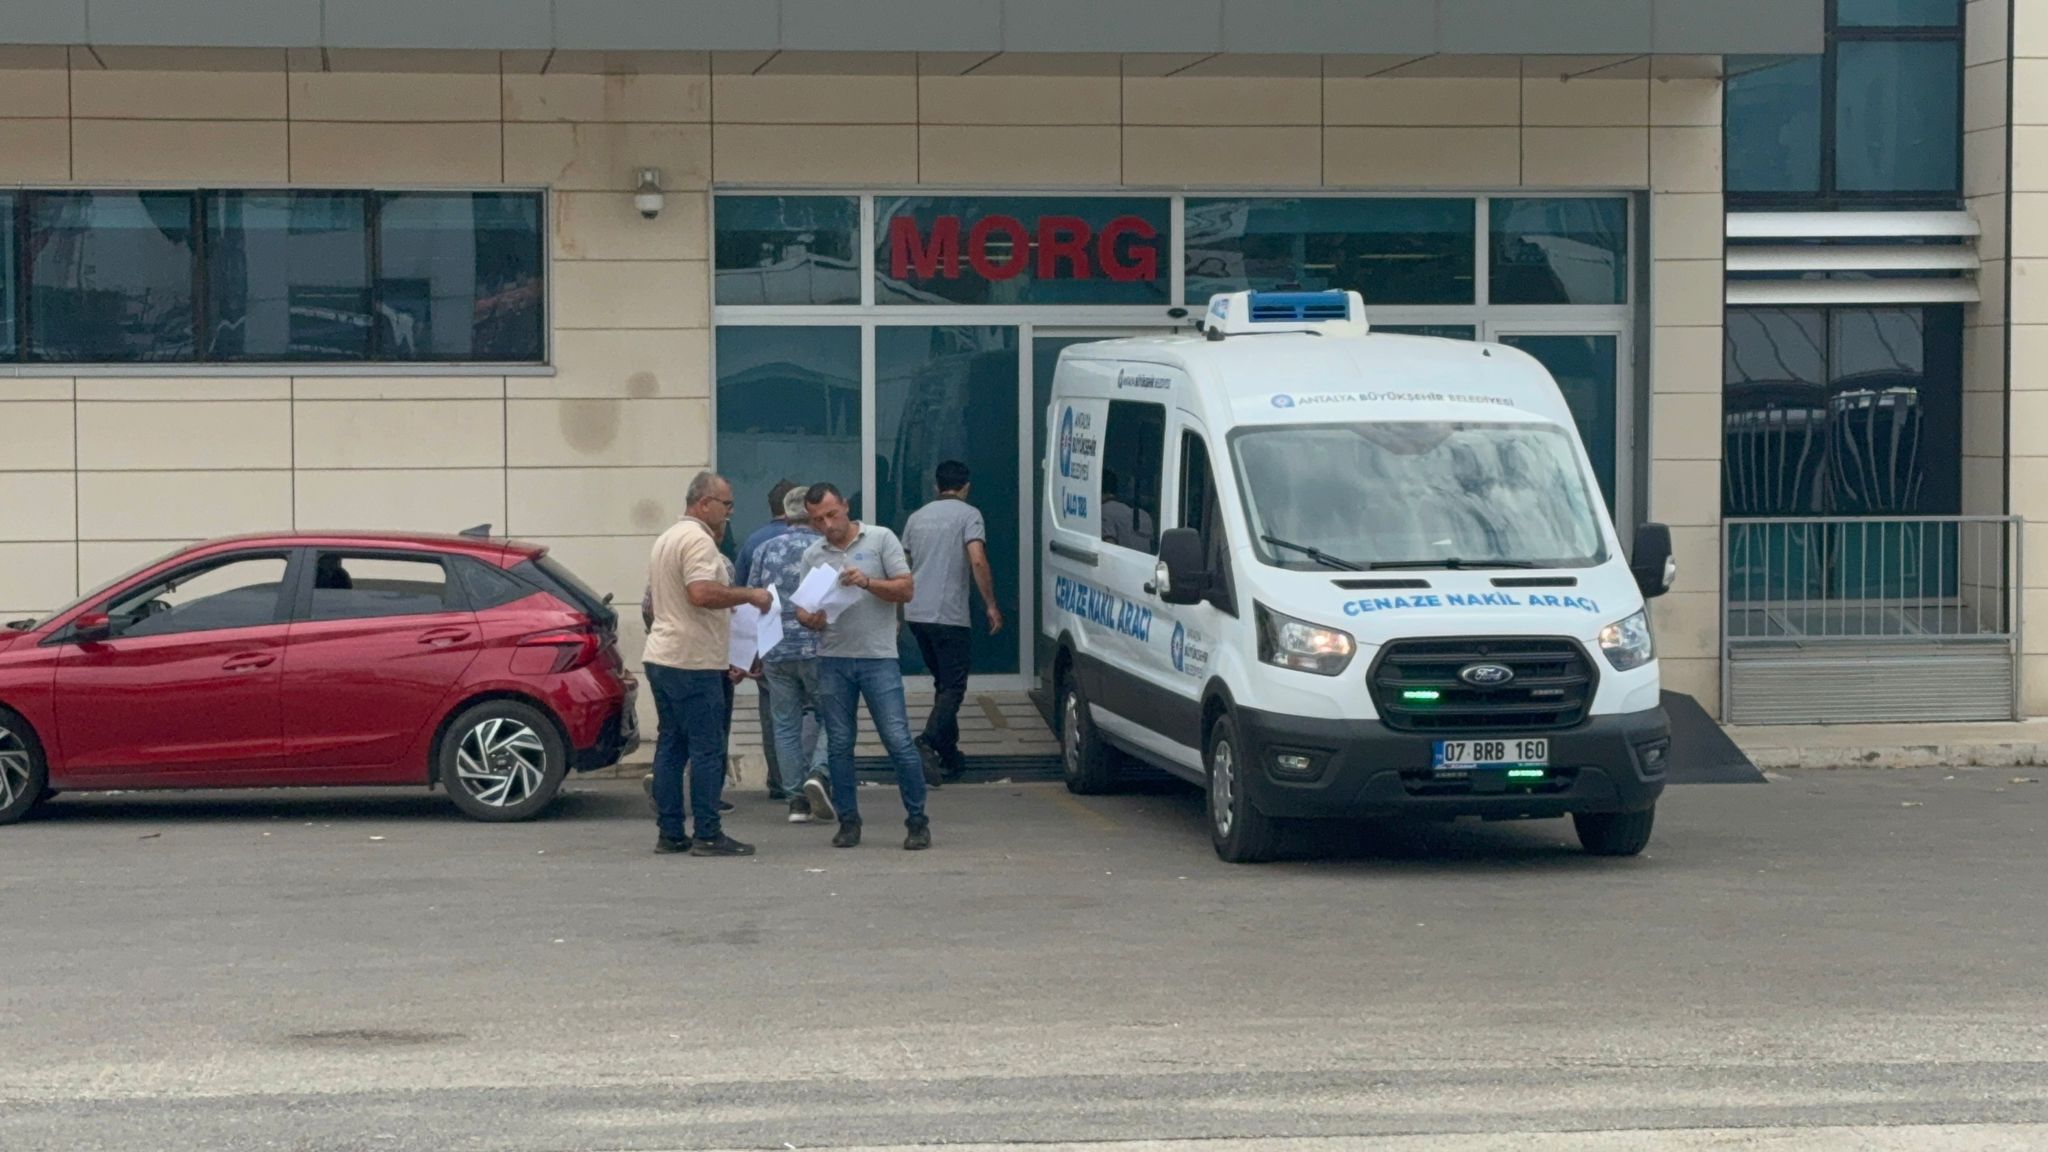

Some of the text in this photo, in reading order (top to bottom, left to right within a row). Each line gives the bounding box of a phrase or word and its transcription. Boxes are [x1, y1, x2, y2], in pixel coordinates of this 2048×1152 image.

[890, 215, 1158, 281] MORG
[1299, 393, 1357, 406] ANTALYA
[1359, 391, 1444, 403] BÜYÜKŞEHİR
[1056, 575, 1088, 618] CENAZE
[1117, 598, 1152, 643] ARACI
[1343, 594, 1443, 616] CENAZE
[1446, 591, 1521, 606] NAKİL
[1445, 741, 1545, 762] 07 BRB 160
